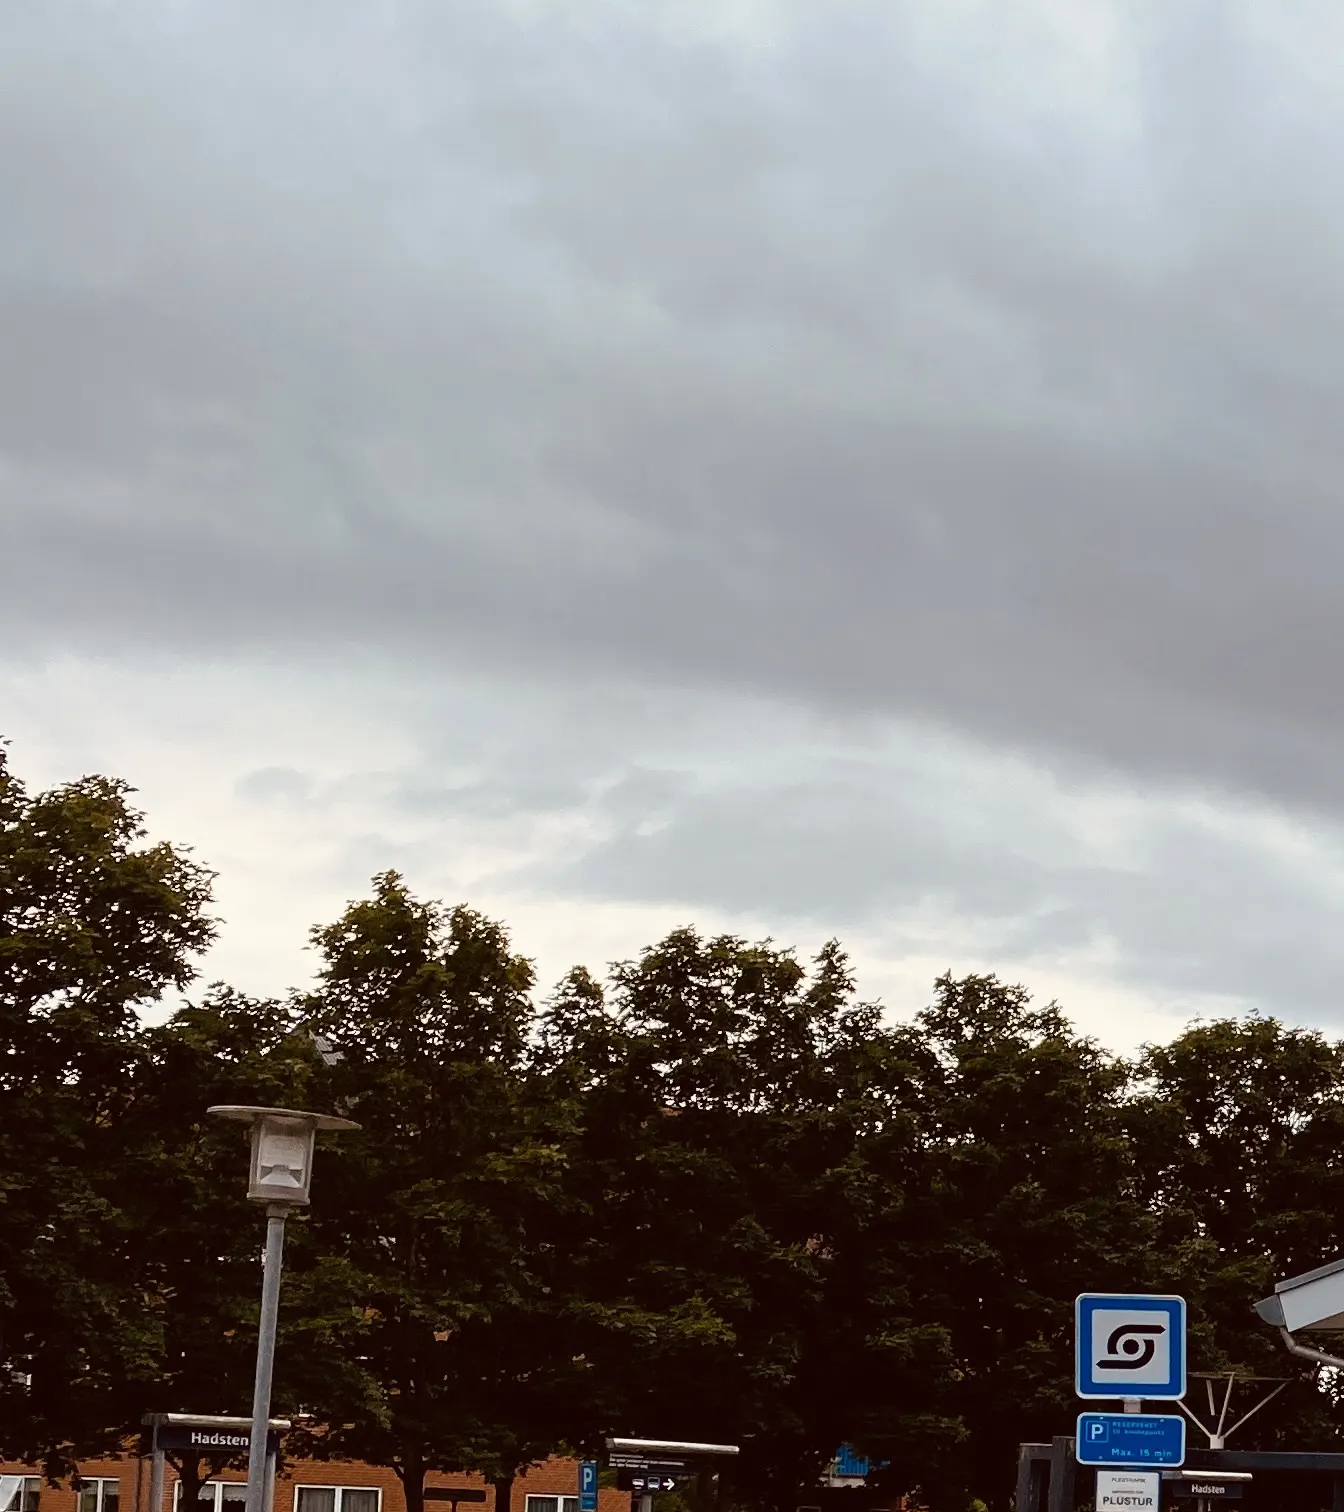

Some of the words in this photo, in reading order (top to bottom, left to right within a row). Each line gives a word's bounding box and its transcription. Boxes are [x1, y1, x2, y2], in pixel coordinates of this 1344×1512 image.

[191, 1432, 249, 1446] Hadsten
[1091, 1424, 1104, 1440] P
[583, 1468, 593, 1490] P
[1191, 1484, 1225, 1494] Hadsten
[1102, 1496, 1153, 1506] PLUSTUR
